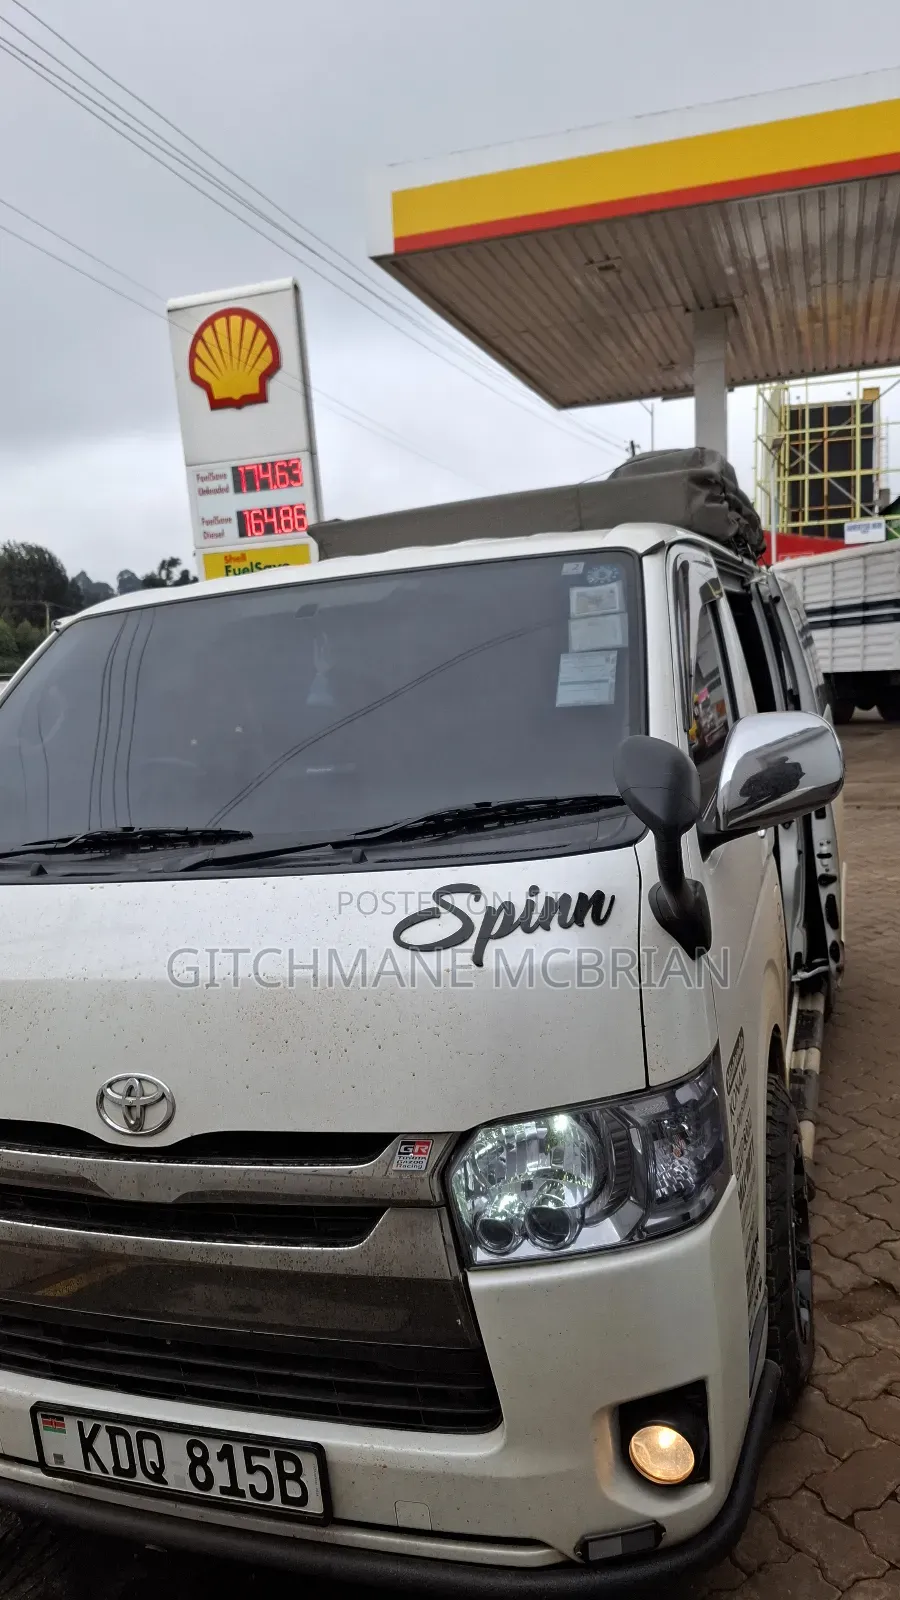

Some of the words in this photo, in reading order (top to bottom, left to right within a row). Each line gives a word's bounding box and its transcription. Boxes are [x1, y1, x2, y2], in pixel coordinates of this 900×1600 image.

[238, 458, 304, 493] 174.63
[243, 503, 309, 537] 164.86
[203, 529, 225, 540] Diesel
[224, 553, 247, 564] Shell
[224, 561, 290, 577] FuelS
[393, 883, 616, 967] Spinn
[400, 1144, 429, 1154] GR
[76, 1419, 169, 1486] KDQ
[185, 1438, 309, 1508] 815B
